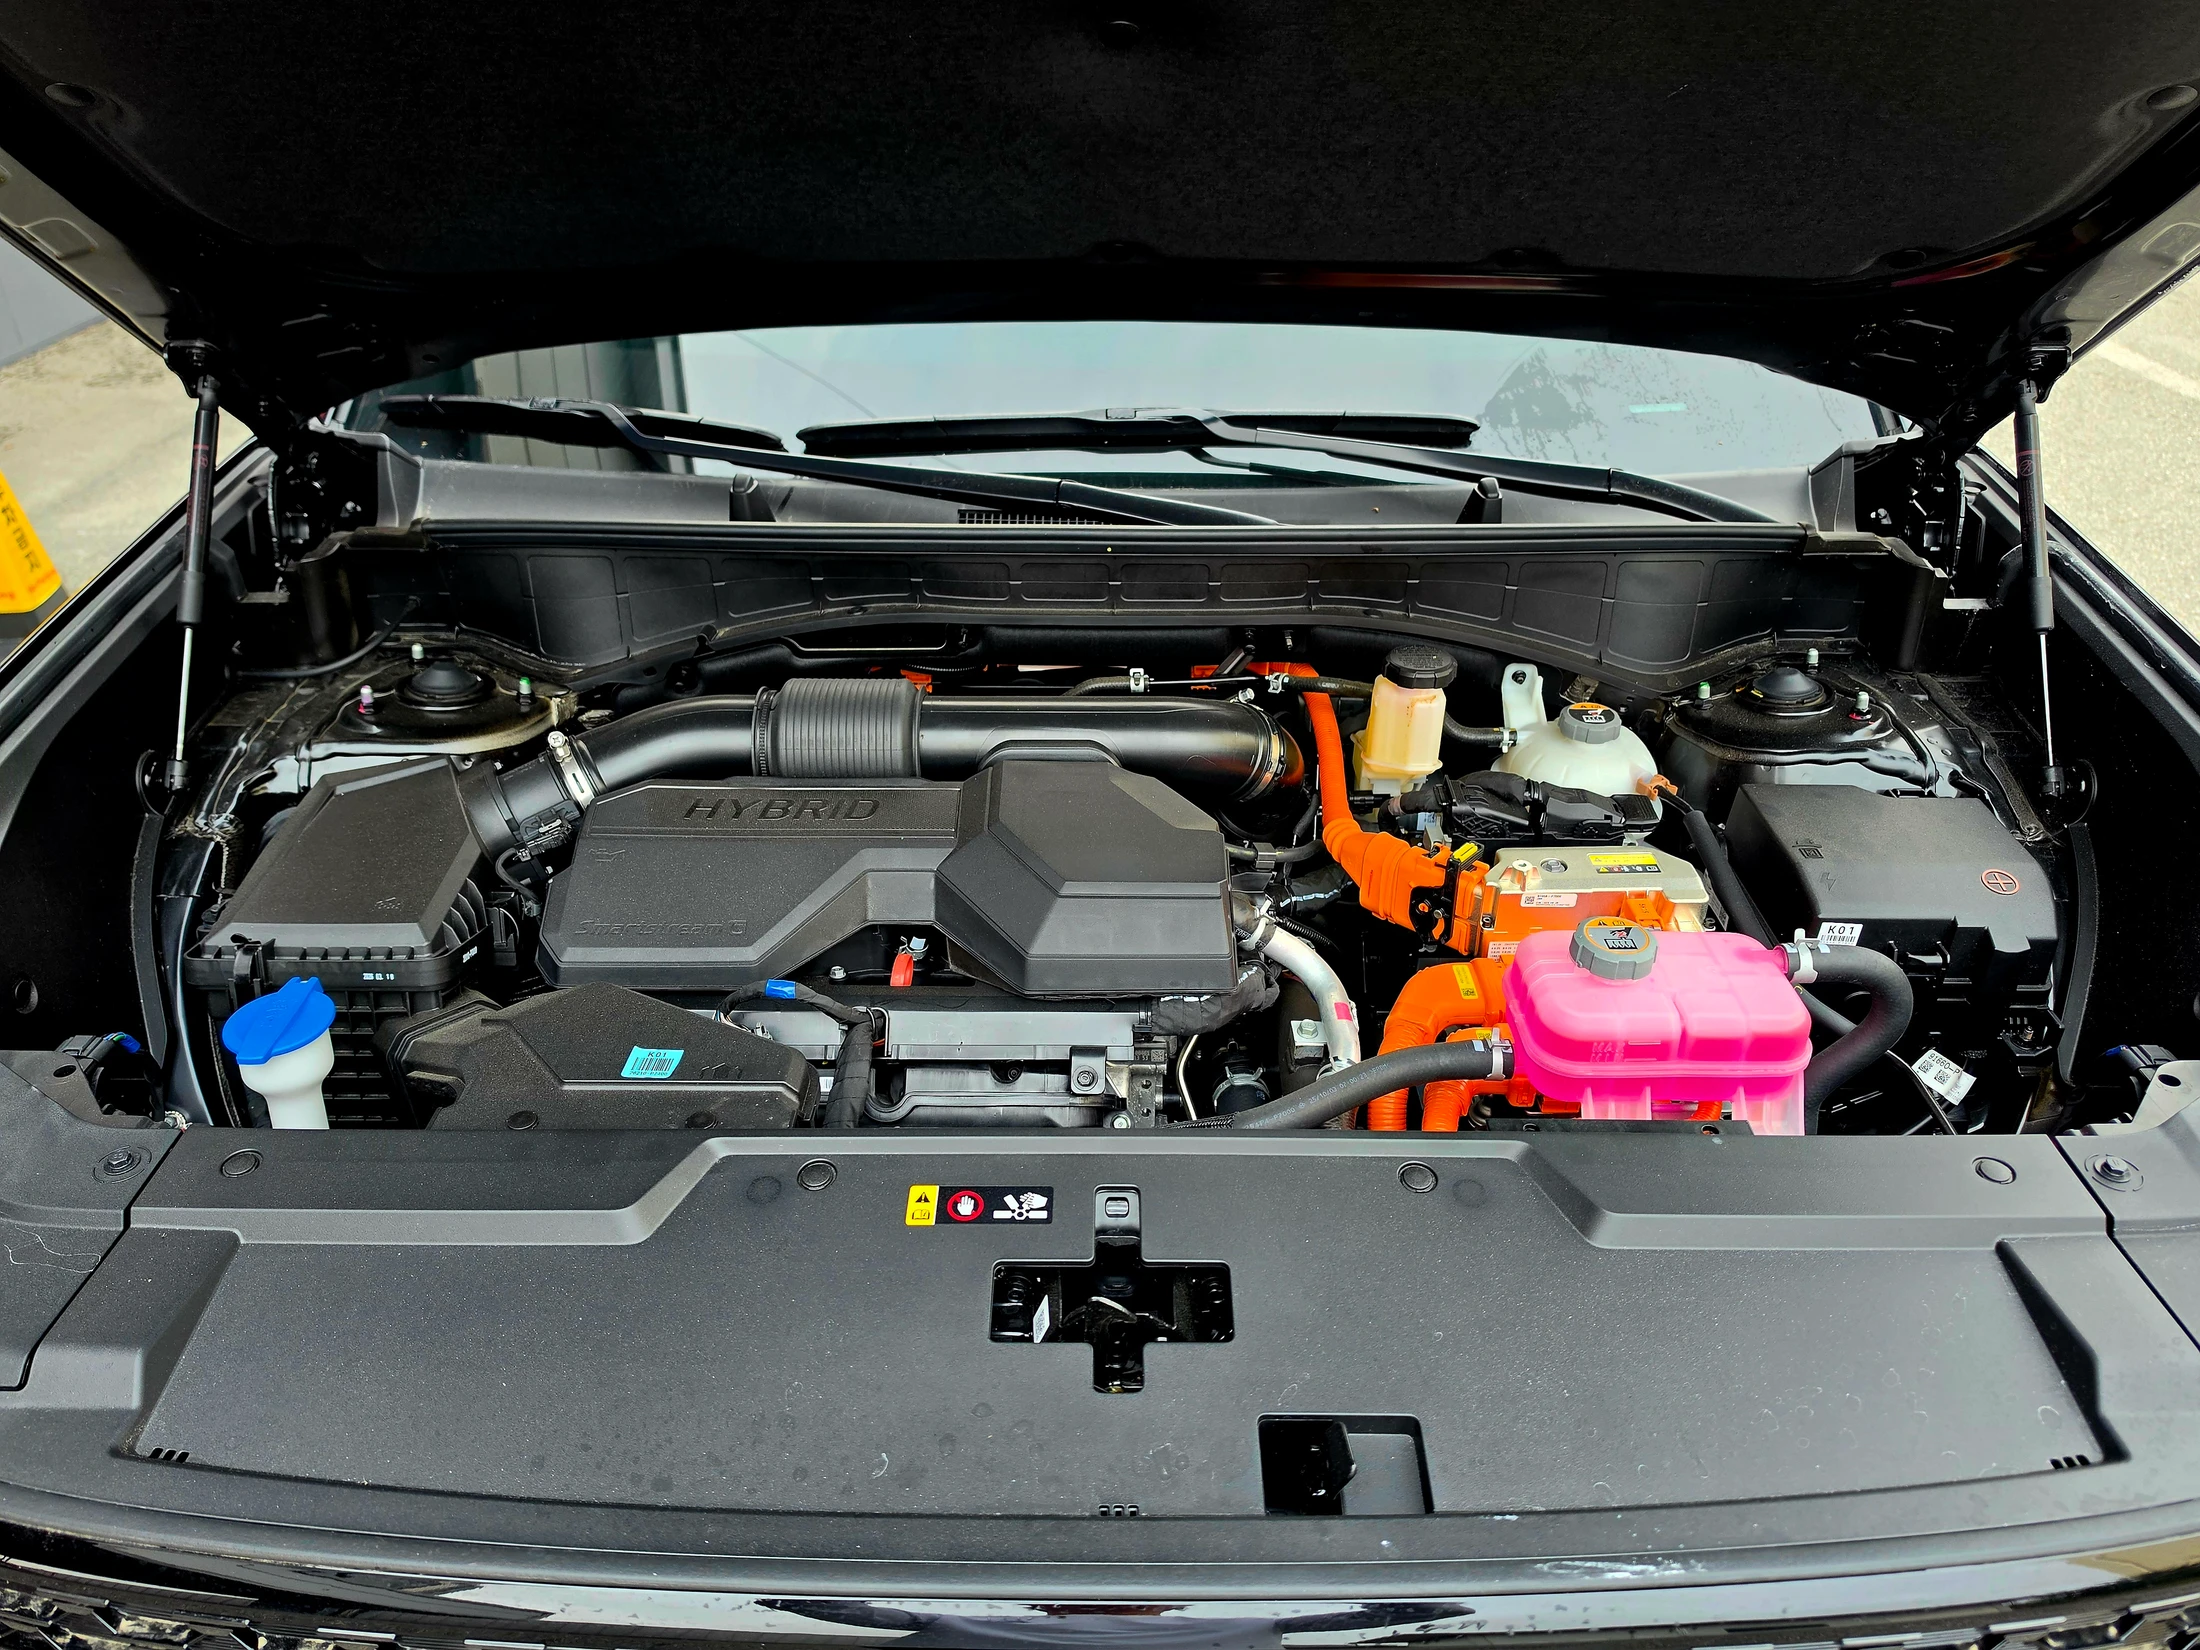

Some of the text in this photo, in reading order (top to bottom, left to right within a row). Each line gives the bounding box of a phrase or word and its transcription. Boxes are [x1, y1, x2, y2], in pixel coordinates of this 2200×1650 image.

[683, 798, 880, 821] HYBRID
[575, 919, 723, 935] Smartstream
[1828, 925, 1855, 935] K01
